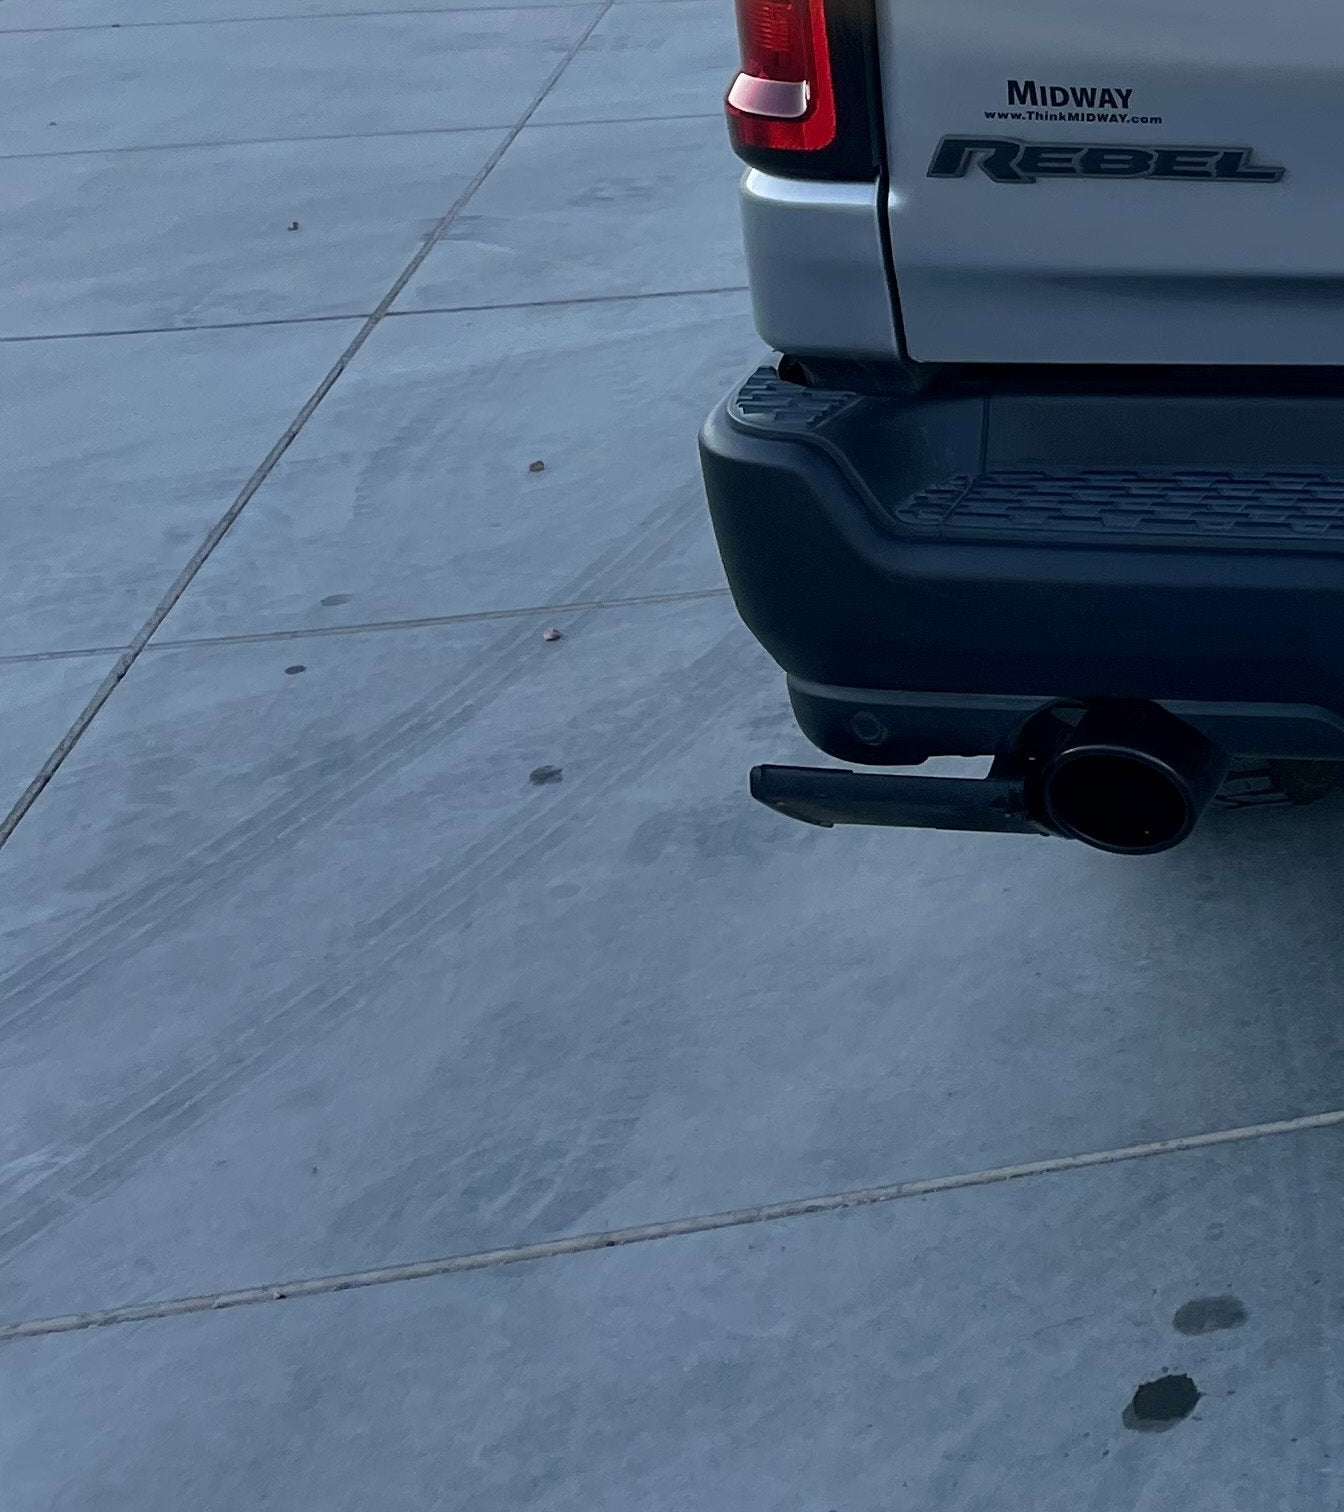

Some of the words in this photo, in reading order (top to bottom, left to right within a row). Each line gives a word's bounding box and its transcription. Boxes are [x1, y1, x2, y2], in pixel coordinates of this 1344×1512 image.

[1006, 79, 1133, 110] MIDWAY
[983, 109, 1163, 125] www.ThinkMIDWAY.com
[926, 134, 1286, 184] REBEL
